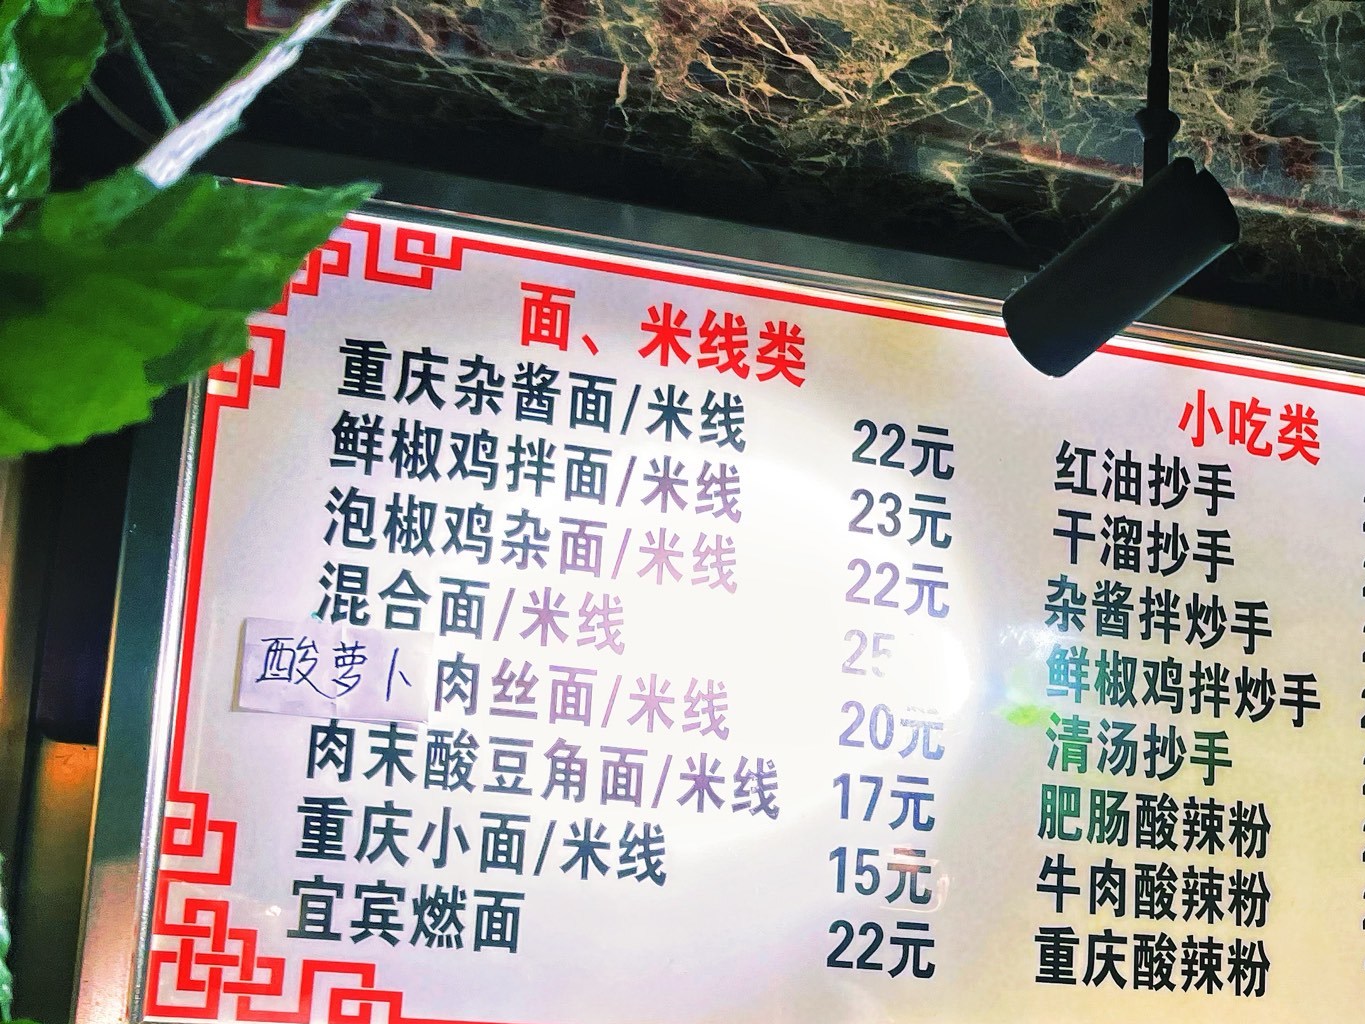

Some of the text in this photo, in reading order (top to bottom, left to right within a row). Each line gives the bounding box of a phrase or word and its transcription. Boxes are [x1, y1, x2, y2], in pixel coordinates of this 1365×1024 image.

[519, 281, 806, 386] 面、米线类
[336, 337, 956, 481] 重庆杂酱面/米线 22元
[1178, 388, 1320, 465] 小吃类
[330, 411, 953, 549] 鲜椒鸡拌面/米线 23元
[1053, 440, 1236, 516] 红油抄手
[323, 485, 950, 619] 泡椒鸡杂面/米线 22元
[1052, 508, 1235, 584] 干溜抄手
[316, 560, 626, 656] 混合面/米线
[1044, 573, 1273, 655] 杂酱拌炒手
[254, 633, 413, 702] 酸萝卜
[433, 651, 946, 761] 肉丝面/米线 20元
[1044, 642, 1322, 728] 鲜椒鸡拌炒手
[304, 720, 937, 834] 肉末酸豆角面/米线 17元
[1045, 711, 1233, 787] 清汤抄手
[294, 795, 934, 907] 重庆小面/米线 15元
[1036, 783, 1272, 859] 肥肠酸辣粉
[286, 875, 937, 981] 宜宾燃面 22元
[1035, 854, 1272, 928] 牛肉酸辣粉
[1033, 925, 1271, 998] 重庆酸辣粉
